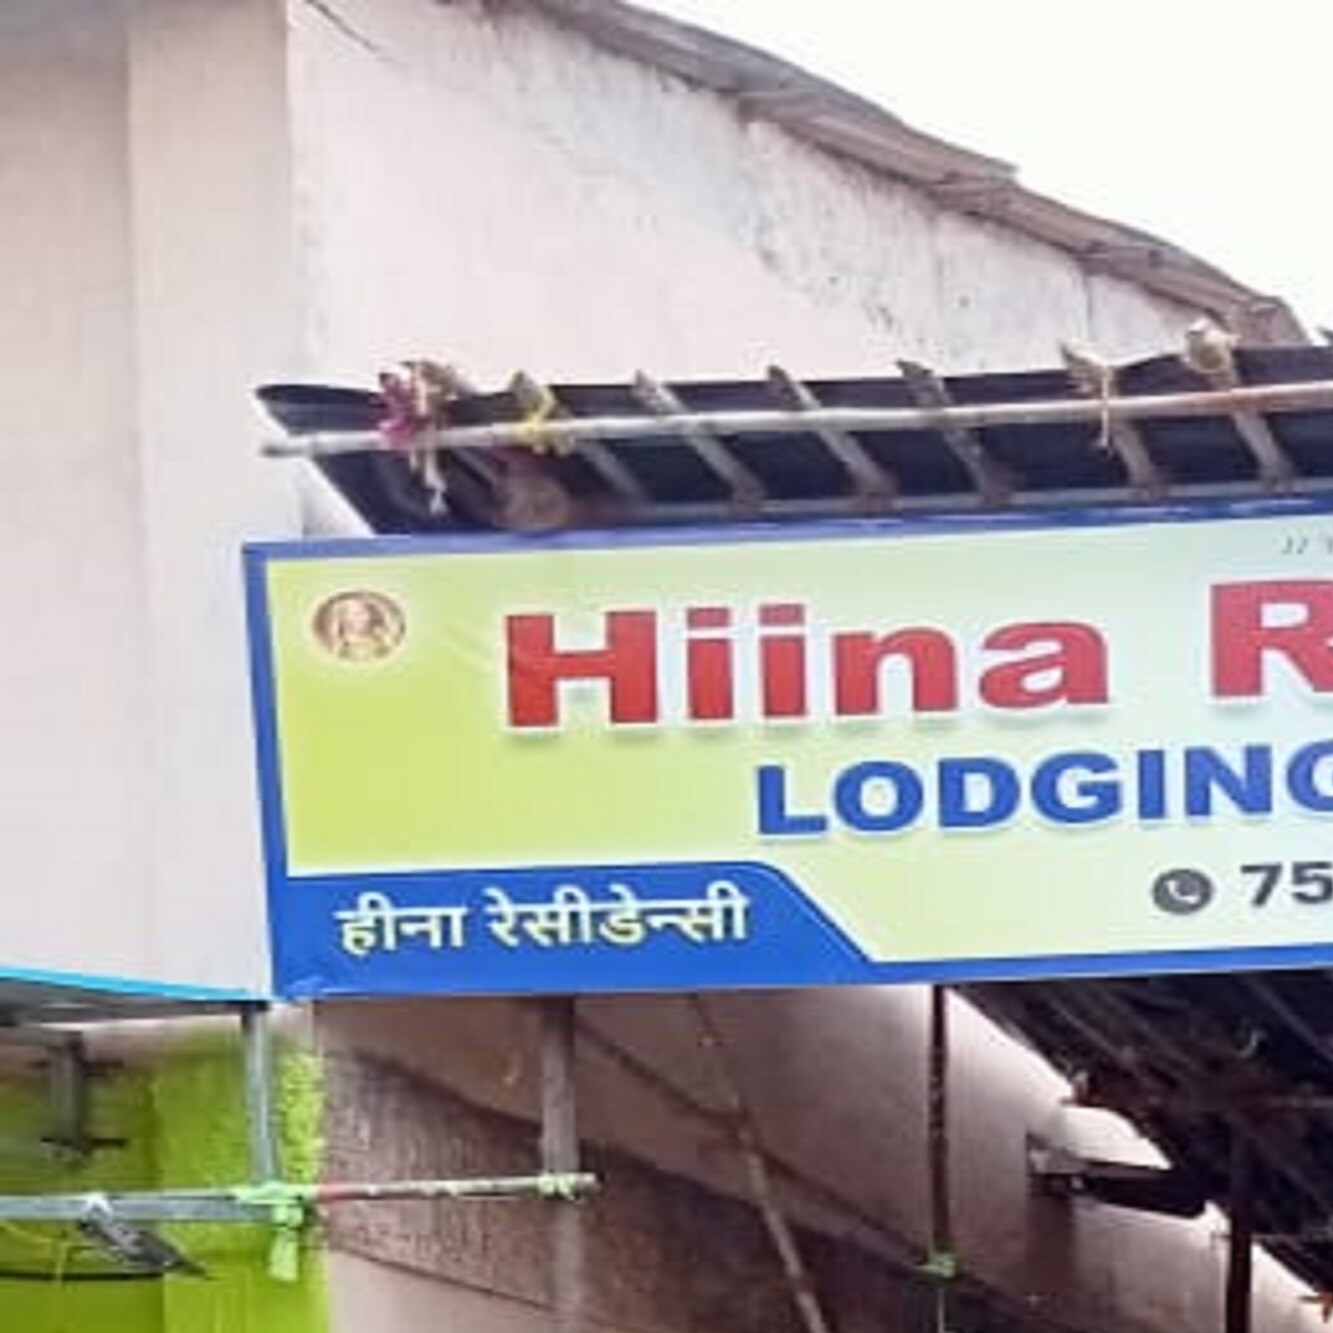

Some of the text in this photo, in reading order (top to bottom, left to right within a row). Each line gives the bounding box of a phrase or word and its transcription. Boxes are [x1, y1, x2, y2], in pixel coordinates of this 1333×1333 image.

[503, 603, 1110, 728] Hiina
[334, 879, 750, 957] हीना रेसीडेन्सी
